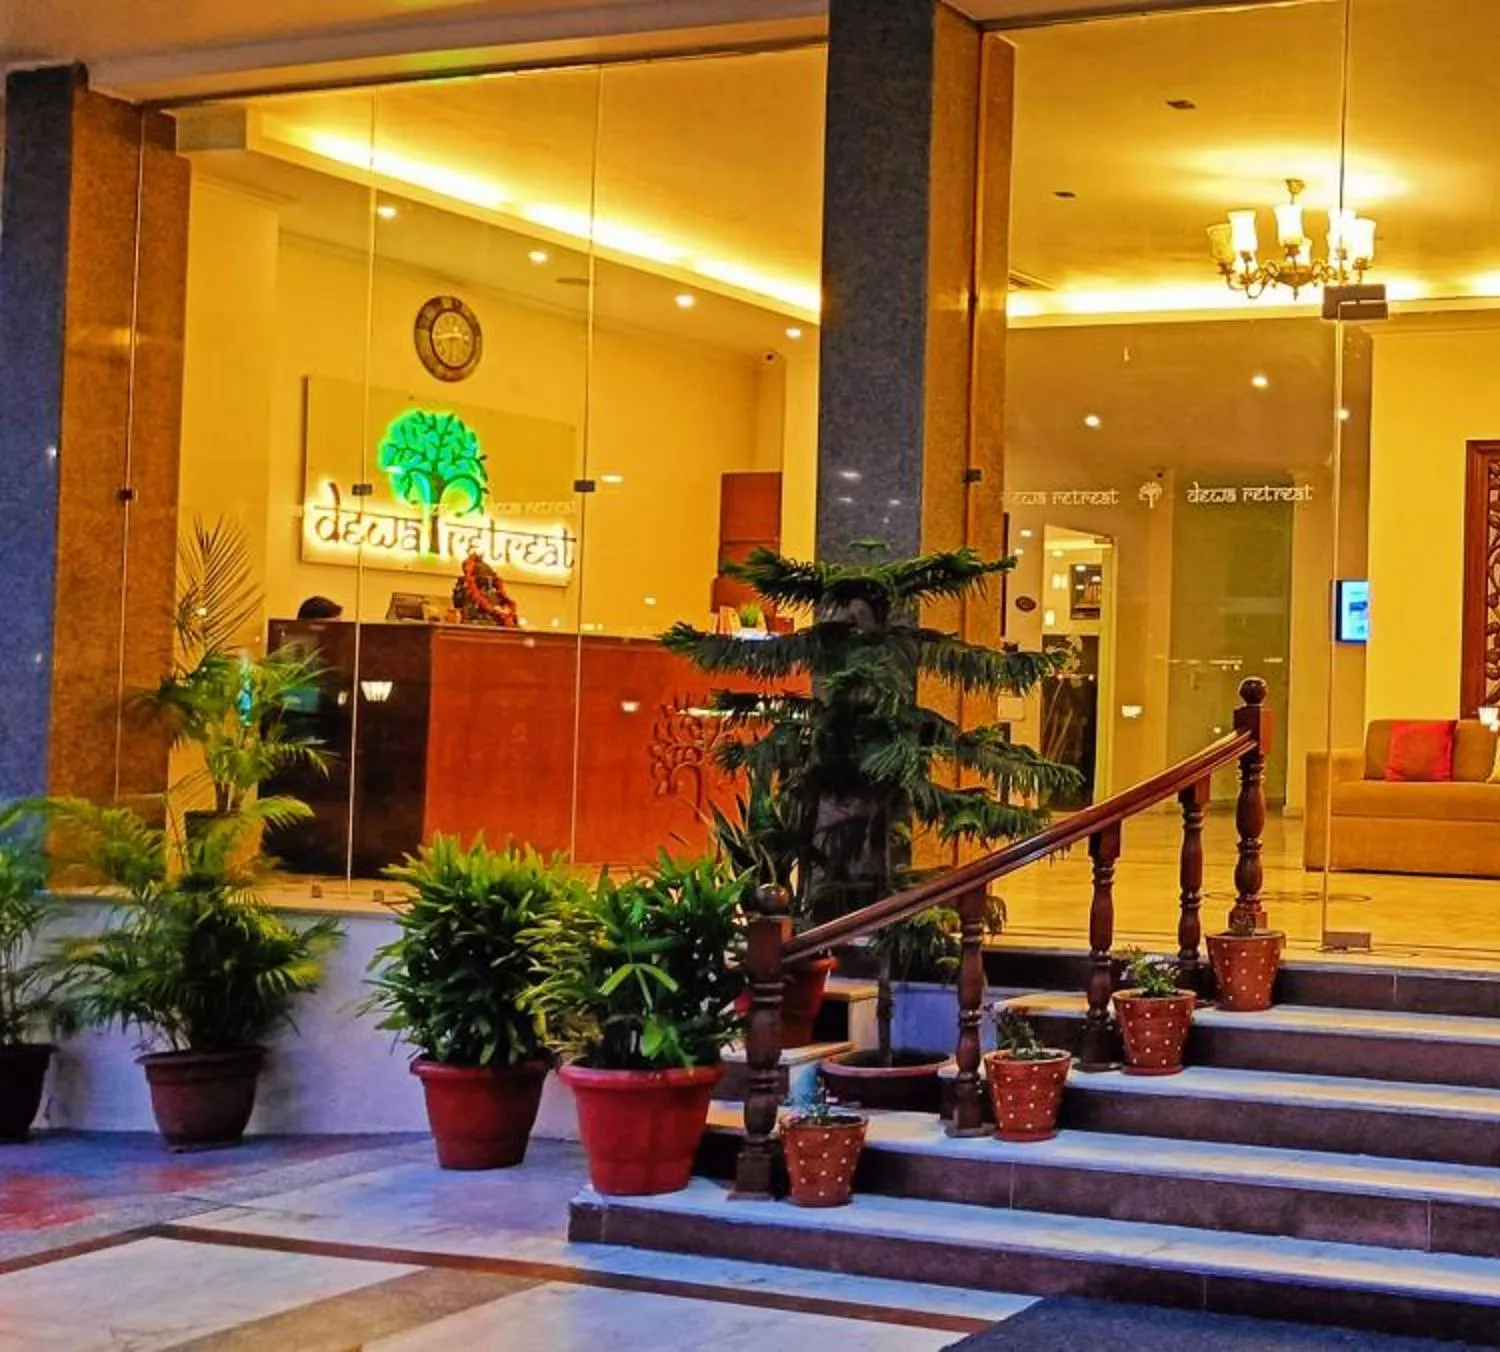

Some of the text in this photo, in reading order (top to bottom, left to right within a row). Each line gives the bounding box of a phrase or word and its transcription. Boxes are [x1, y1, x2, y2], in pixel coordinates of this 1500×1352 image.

[1052, 488, 1120, 505] retreat
[1187, 481, 1314, 503] dewa retreat
[312, 482, 577, 569] dewa retreat
